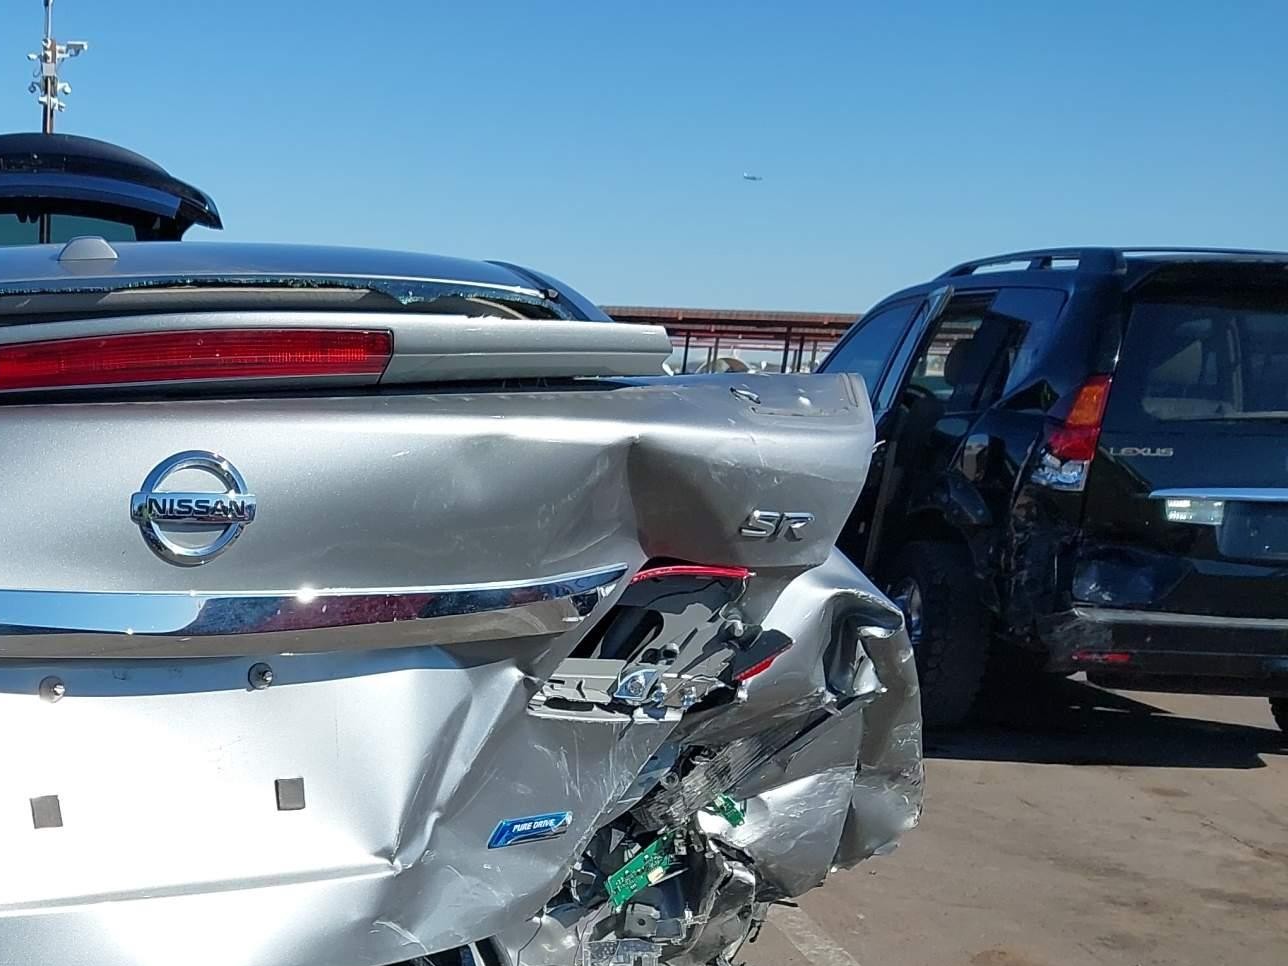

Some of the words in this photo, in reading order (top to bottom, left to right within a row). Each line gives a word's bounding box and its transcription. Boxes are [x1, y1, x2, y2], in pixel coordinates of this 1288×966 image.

[1110, 447, 1174, 456] LEXUS
[146, 497, 245, 516] NISSAN
[739, 510, 815, 541] SR
[512, 822, 533, 832] PURE
[533, 819, 555, 829] DRIVE
